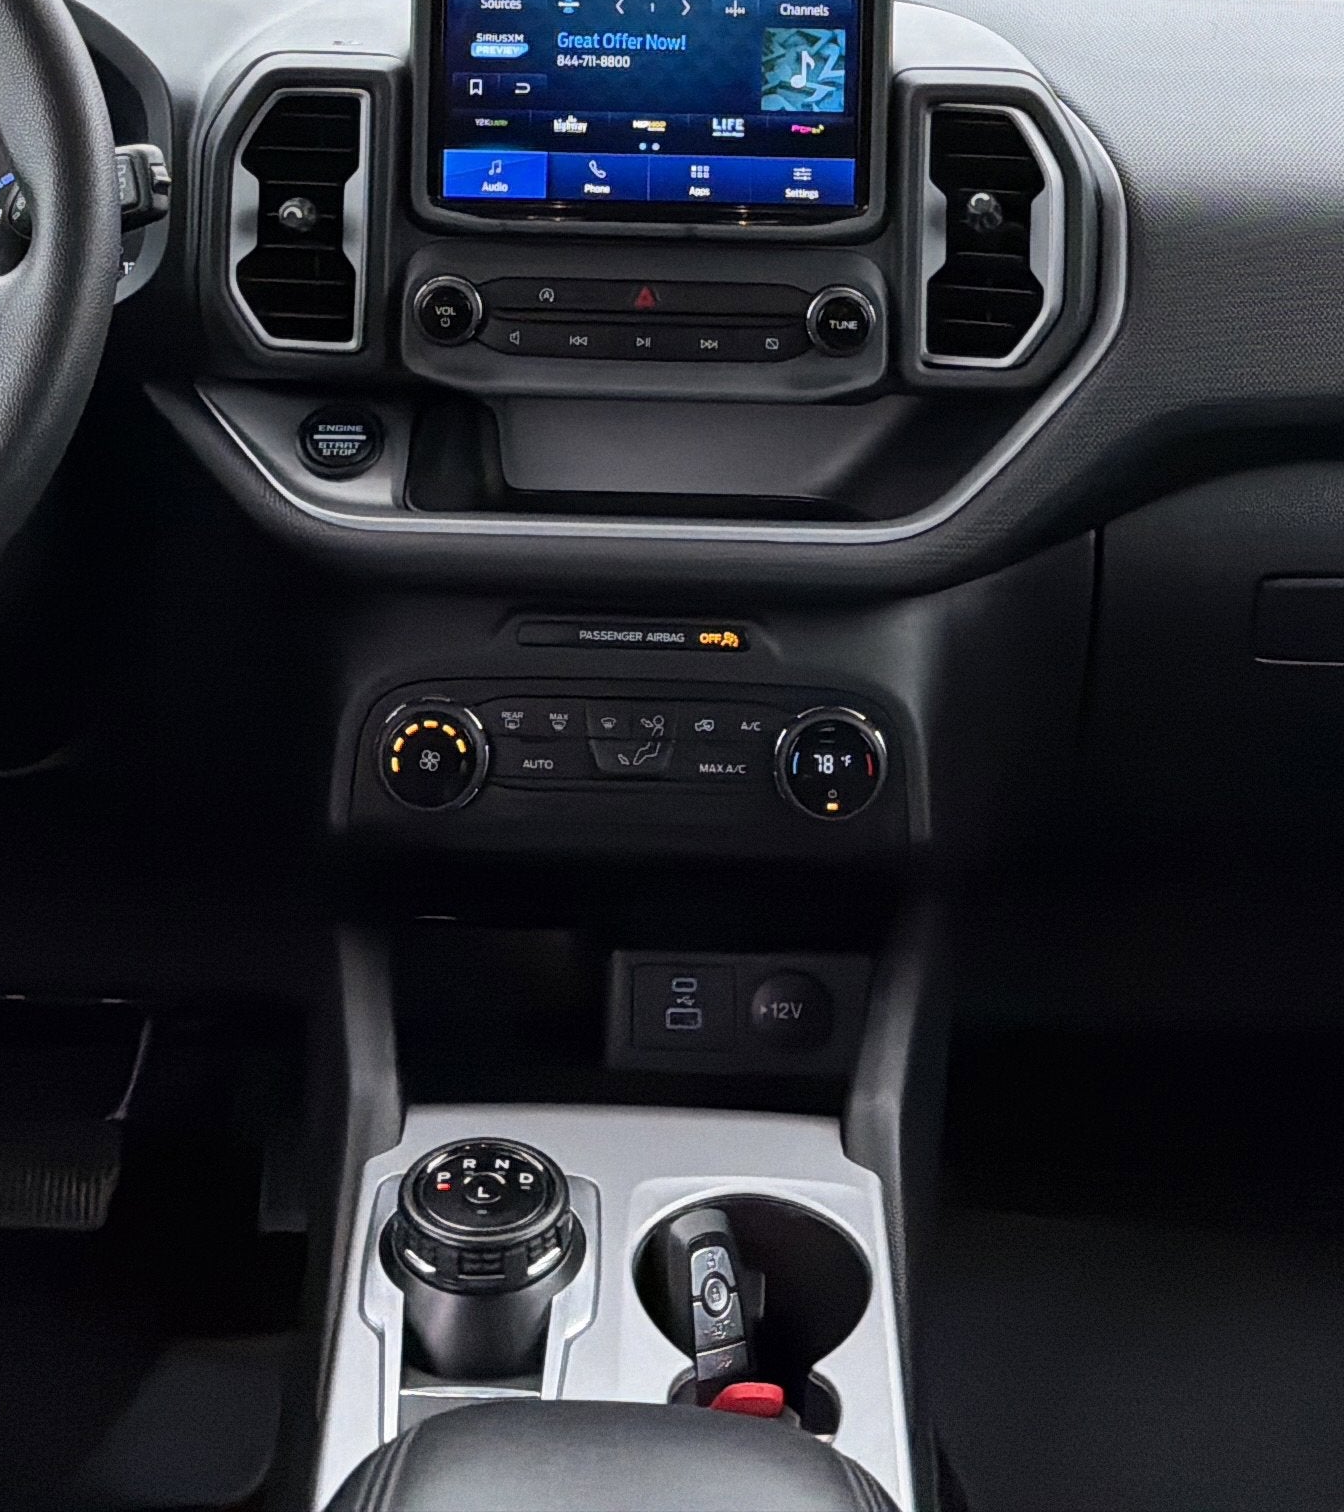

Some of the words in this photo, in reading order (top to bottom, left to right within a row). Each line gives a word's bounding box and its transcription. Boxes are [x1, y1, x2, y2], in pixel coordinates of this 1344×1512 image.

[780, 2, 830, 17] Channels
[557, 32, 600, 49] Great
[602, 33, 643, 49] Offer
[645, 34, 686, 51] Now!
[557, 54, 630, 68] 844-711-8800
[712, 118, 745, 131] LIFE
[482, 181, 508, 194] Audio
[584, 184, 611, 195] Phone
[689, 186, 710, 198] Apps
[785, 187, 819, 201] Settings
[434, 306, 456, 317] VOL
[829, 319, 858, 331] TUNE
[318, 424, 364, 432] ENGINE
[318, 441, 361, 449] START
[322, 448, 357, 456] STOP
[579, 630, 643, 642] PASSENGER
[646, 632, 685, 643] AIRBAG
[699, 633, 722, 644] OFF
[501, 711, 524, 720] REAR
[549, 713, 568, 721] MAX
[741, 721, 761, 731] A/C
[523, 759, 554, 770] AUTO
[699, 763, 724, 774] MAX
[726, 764, 747, 774] A/C
[813, 754, 834, 775] 78
[770, 1001, 803, 1020] 12V
[462, 1158, 477, 1169] R
[495, 1159, 510, 1169] N
[437, 1171, 452, 1183] P
[519, 1172, 534, 1184] D
[477, 1186, 490, 1198] L
